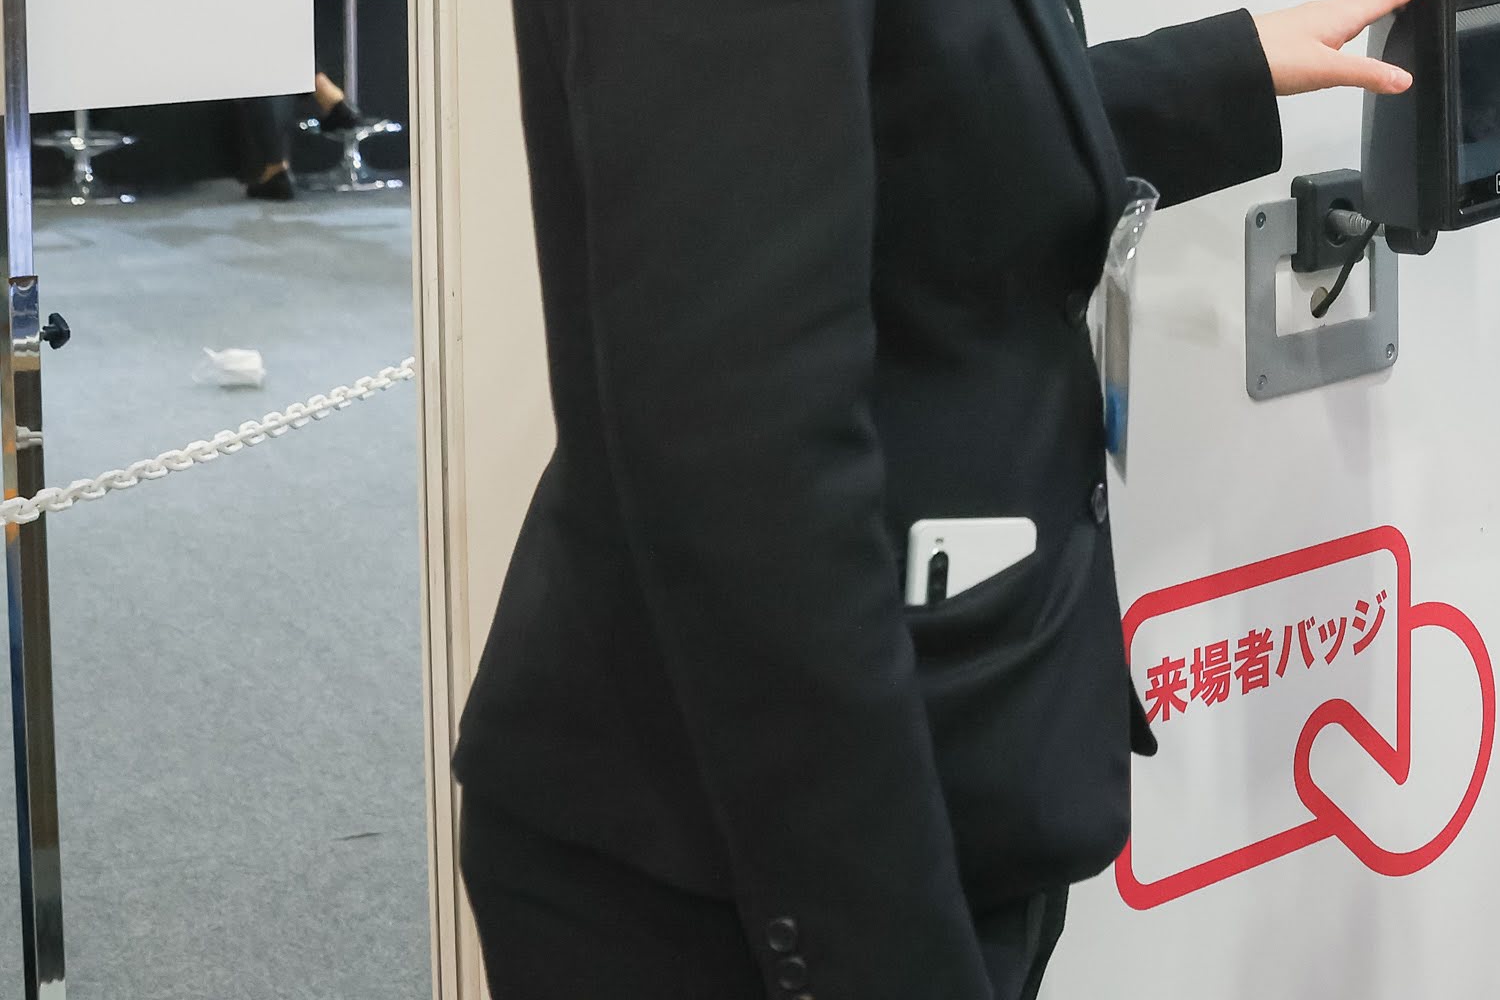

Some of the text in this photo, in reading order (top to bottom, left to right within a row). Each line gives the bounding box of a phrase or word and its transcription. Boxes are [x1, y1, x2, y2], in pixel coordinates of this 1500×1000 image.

[1144, 589, 1388, 724] 来場者バッジ
